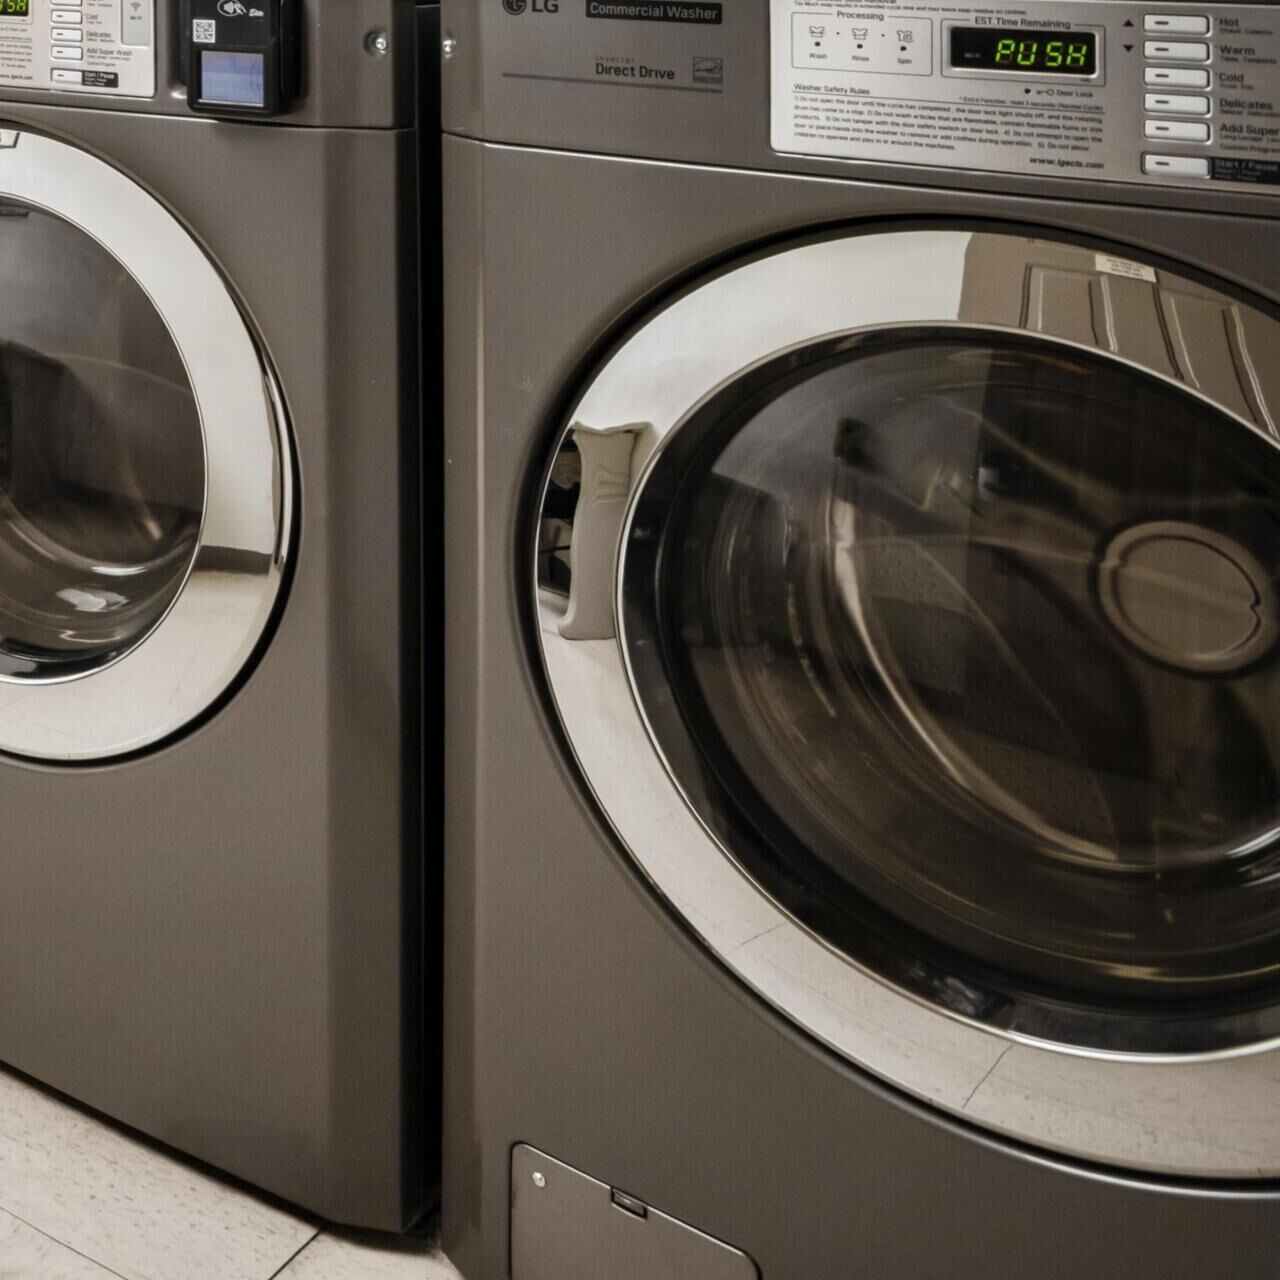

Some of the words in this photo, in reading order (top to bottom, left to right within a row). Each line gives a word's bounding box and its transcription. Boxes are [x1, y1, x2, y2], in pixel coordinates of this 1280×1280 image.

[590, 2, 663, 17] Commercial
[666, 6, 718, 20] Washer
[837, 11, 884, 21] Processing
[996, 18, 1018, 26] Time
[1020, 19, 1071, 30] Remaining
[1220, 17, 1239, 27] Hot
[995, 40, 1087, 66] PUSH
[1220, 46, 1255, 55] Warm
[596, 63, 636, 77] Direct
[639, 66, 675, 80] Drive
[1219, 72, 1244, 82] Cold
[824, 86, 848, 94] Safety
[1220, 99, 1272, 110] Delicates
[1220, 124, 1243, 133] Add
[1246, 125, 1278, 136] Super
